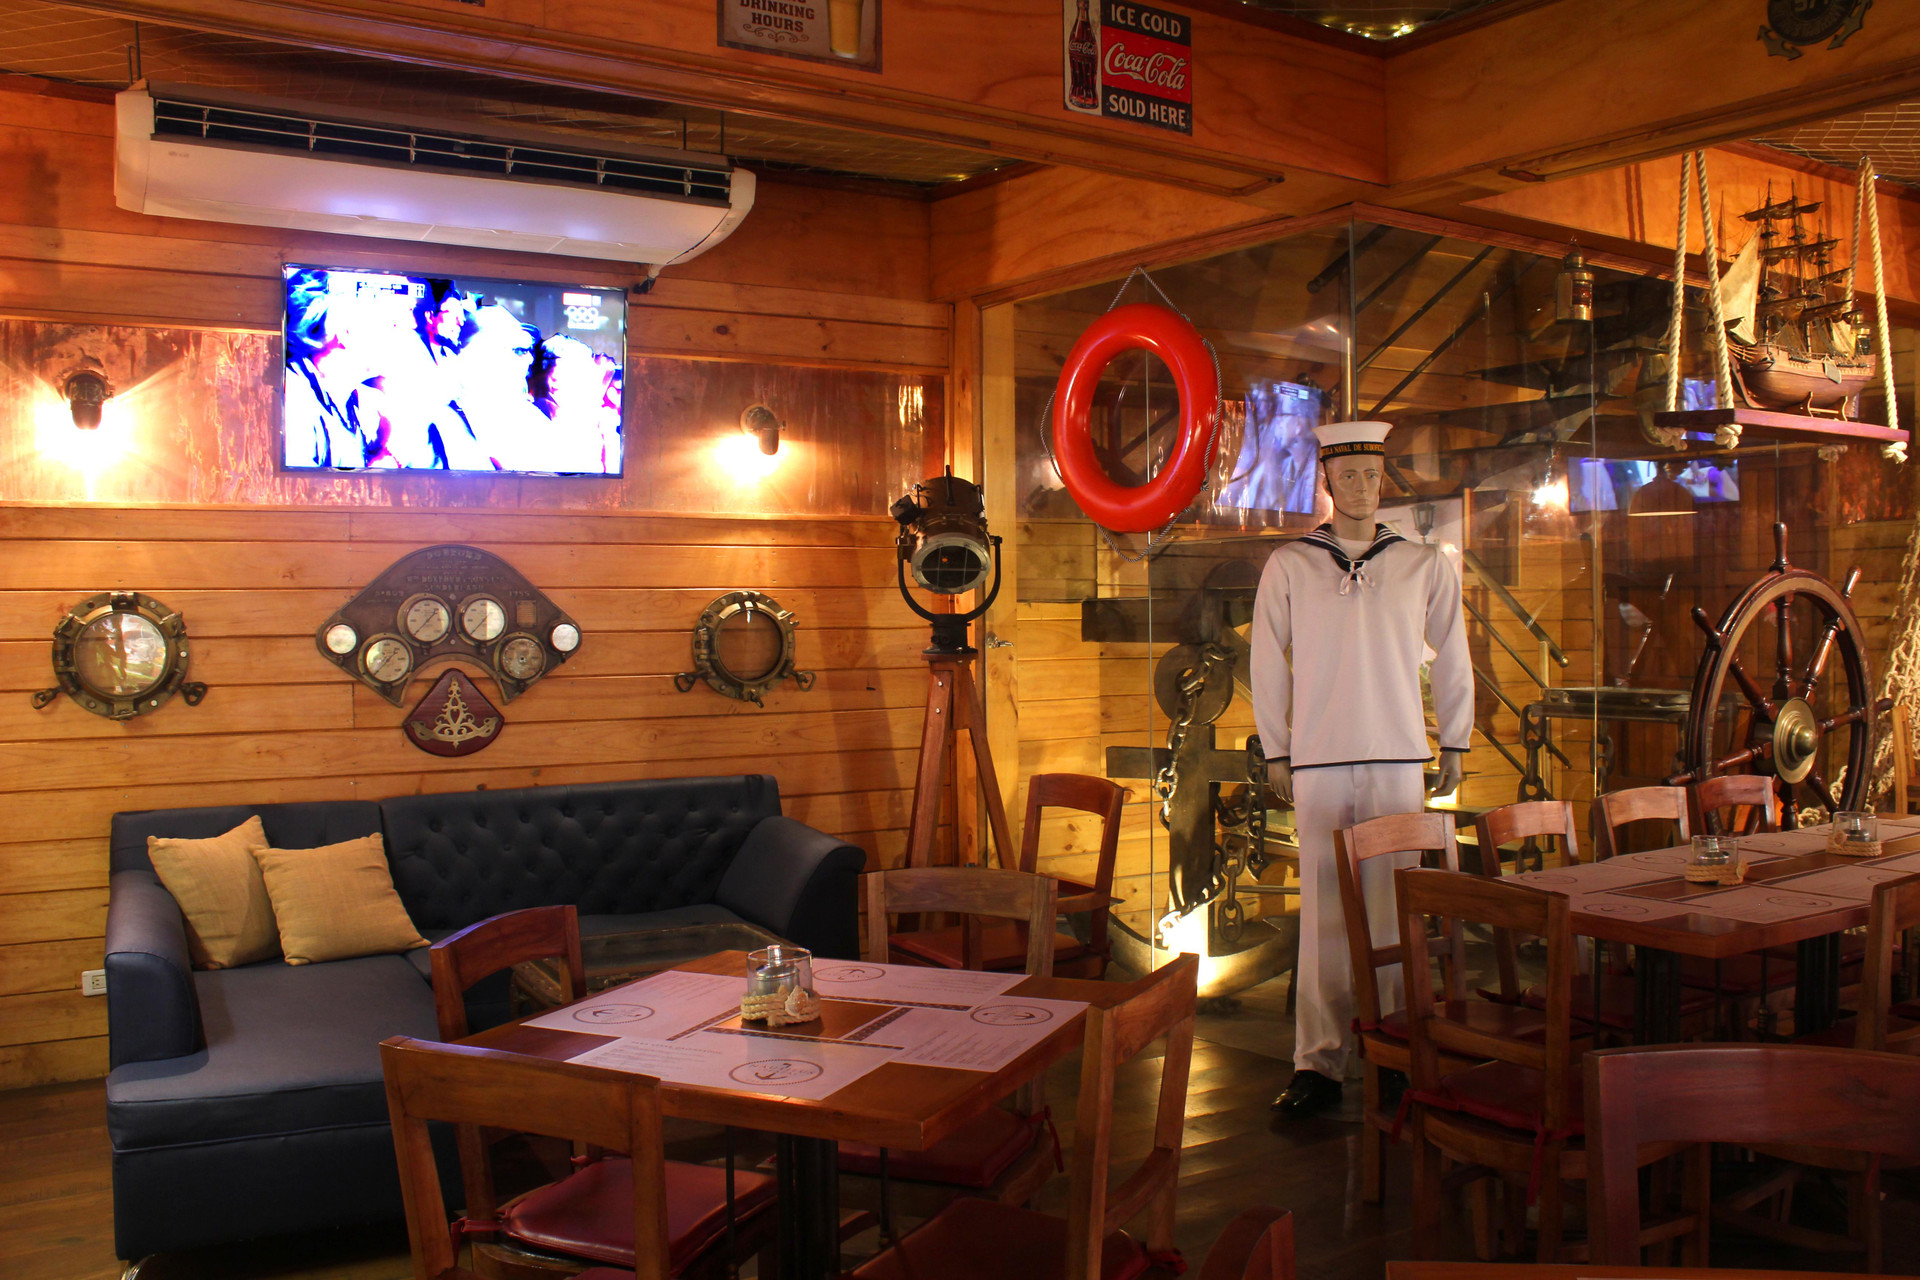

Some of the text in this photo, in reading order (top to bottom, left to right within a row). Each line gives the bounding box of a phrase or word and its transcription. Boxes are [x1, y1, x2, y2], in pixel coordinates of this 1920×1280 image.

[740, 0, 815, 20] DRINKING
[751, 12, 804, 33] HOURS
[1111, 3, 1181, 38] ICE COLD
[1104, 42, 1190, 91] Coca-Cola
[1108, 94, 1186, 126] SOLD HERE
[1334, 444, 1352, 454] NAVAL
[1354, 443, 1363, 452] DE
